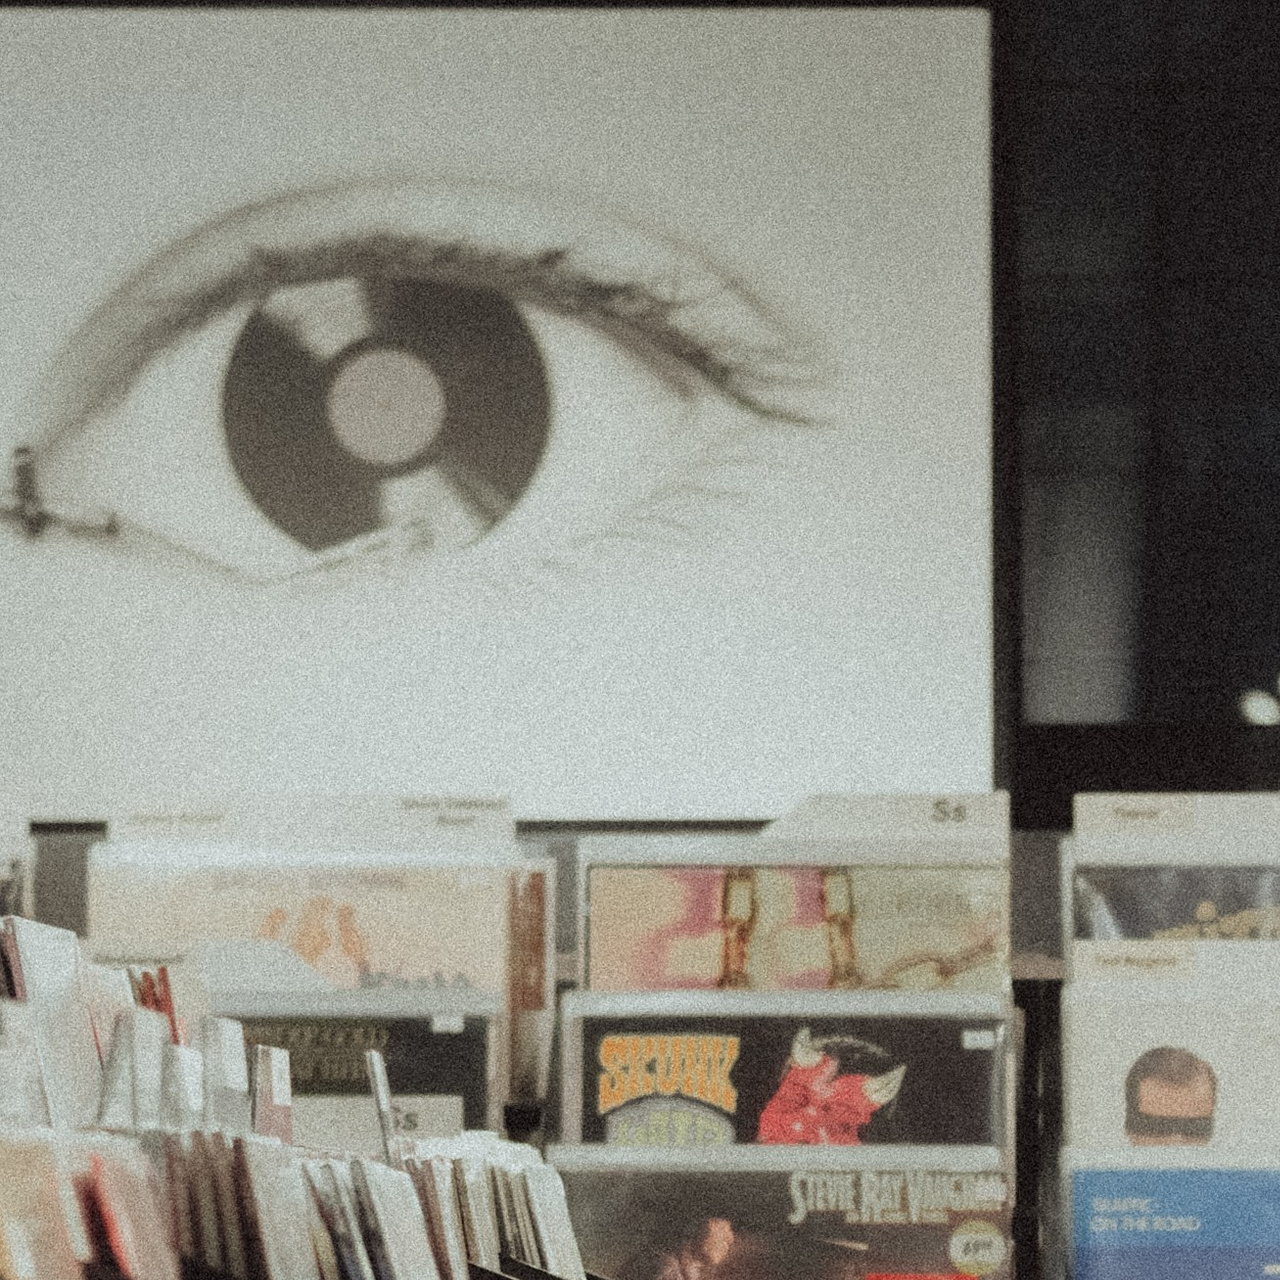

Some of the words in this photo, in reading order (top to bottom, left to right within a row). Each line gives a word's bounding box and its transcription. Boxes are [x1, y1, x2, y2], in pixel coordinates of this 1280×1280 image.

[598, 1034, 740, 1115] SKUNK
[788, 1170, 855, 1225] STEVIE
[861, 1170, 904, 1224] RAY
